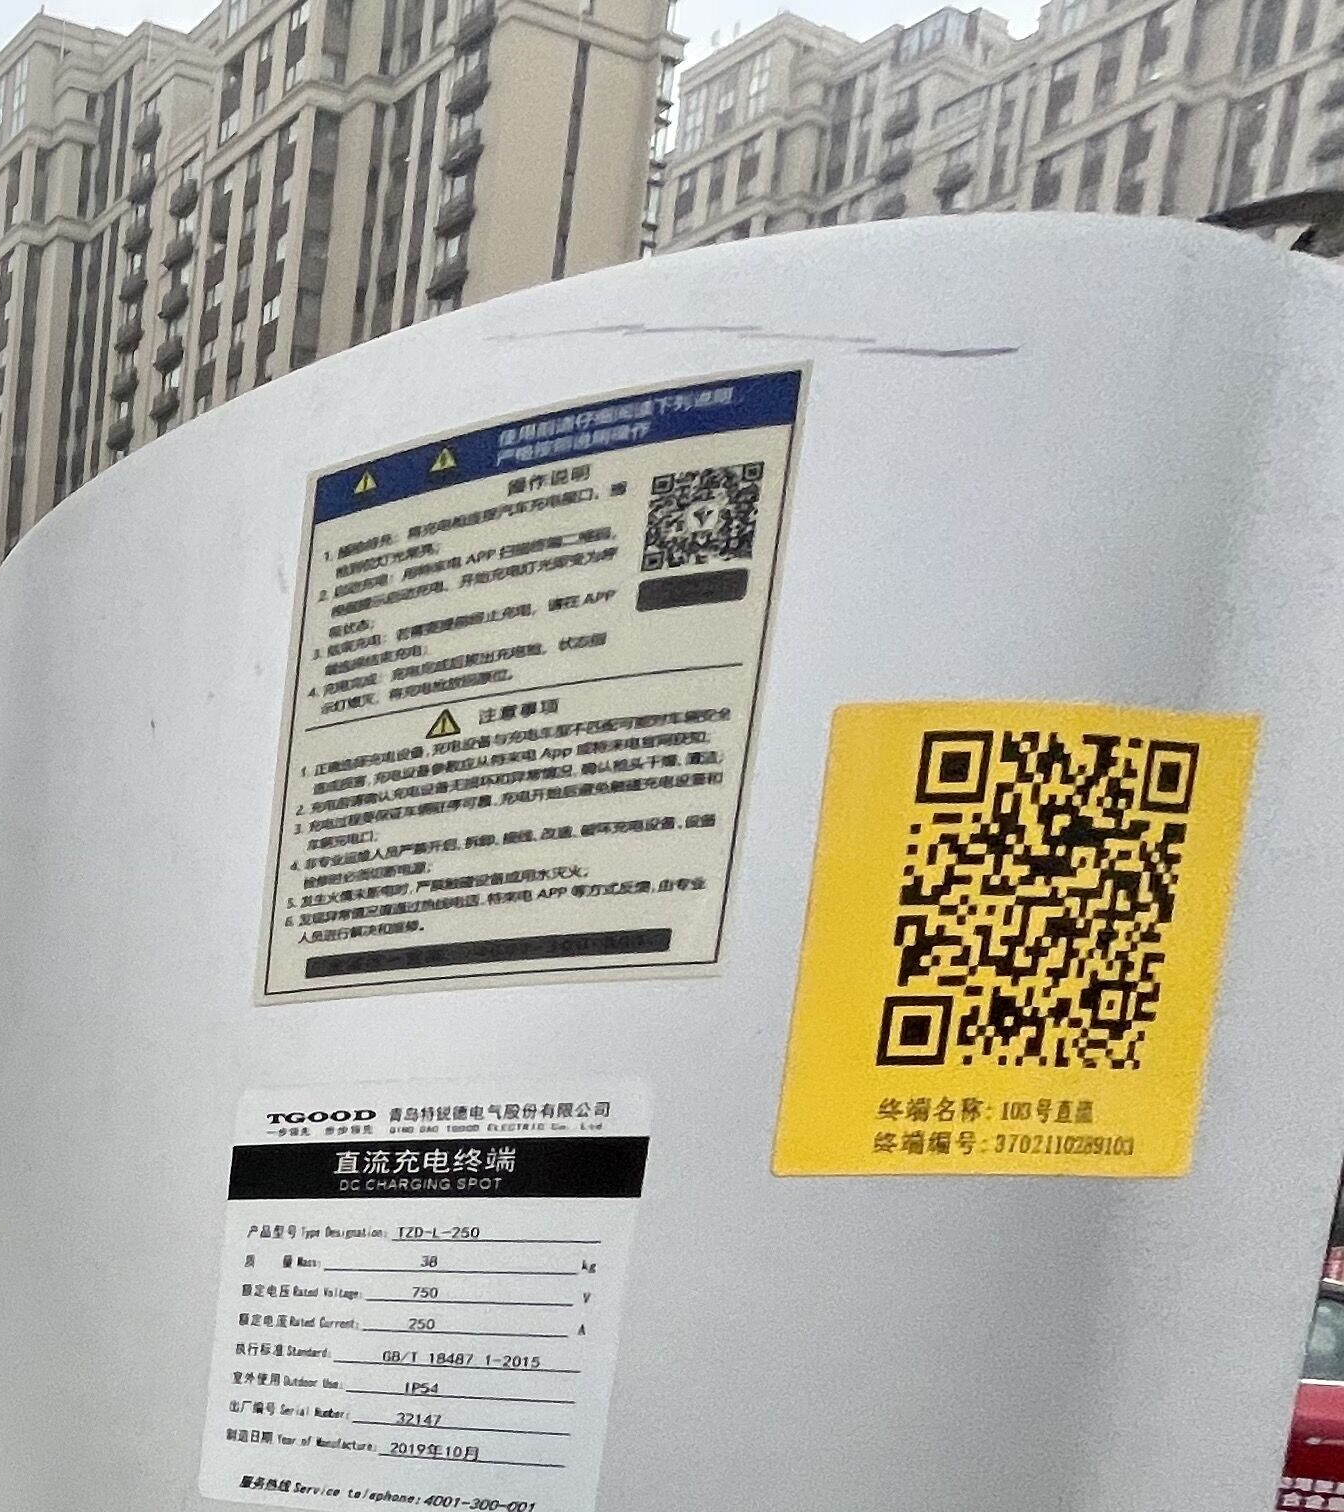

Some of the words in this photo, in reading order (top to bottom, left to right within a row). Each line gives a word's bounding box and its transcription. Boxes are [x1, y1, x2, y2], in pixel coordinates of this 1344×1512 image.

[540, 745, 572, 760] App
[537, 886, 567, 900] APP
[266, 1109, 376, 1124] TGOOD
[388, 1101, 611, 1123] 青岛特锐德电气股份有限公司
[333, 1147, 517, 1175] 直流充电终端
[339, 1178, 361, 1191] DC
[365, 1178, 451, 1191] CHARGING
[456, 1178, 503, 1191] SPOT
[247, 1225, 296, 1240] 产品型号
[397, 1227, 481, 1239] TZD-L-250
[420, 1255, 438, 1268] 38
[582, 1259, 597, 1273] kg
[242, 1283, 290, 1300] 额定电压
[412, 1286, 439, 1299] 750
[408, 1318, 435, 1330] 250
[235, 1342, 283, 1357] 执行标准
[382, 1350, 418, 1363] GB/T
[232, 1371, 280, 1387] 室外使用
[405, 1381, 438, 1395] IP54
[229, 1400, 276, 1418] 出厂编号
[279, 1403, 310, 1418] Serial
[395, 1413, 441, 1426] 32147
[226, 1428, 273, 1444] 制造日期
[277, 1432, 298, 1446] Year
[301, 1434, 311, 1447] of
[390, 1443, 480, 1461] 2019年10月
[293, 1481, 340, 1498] Service
